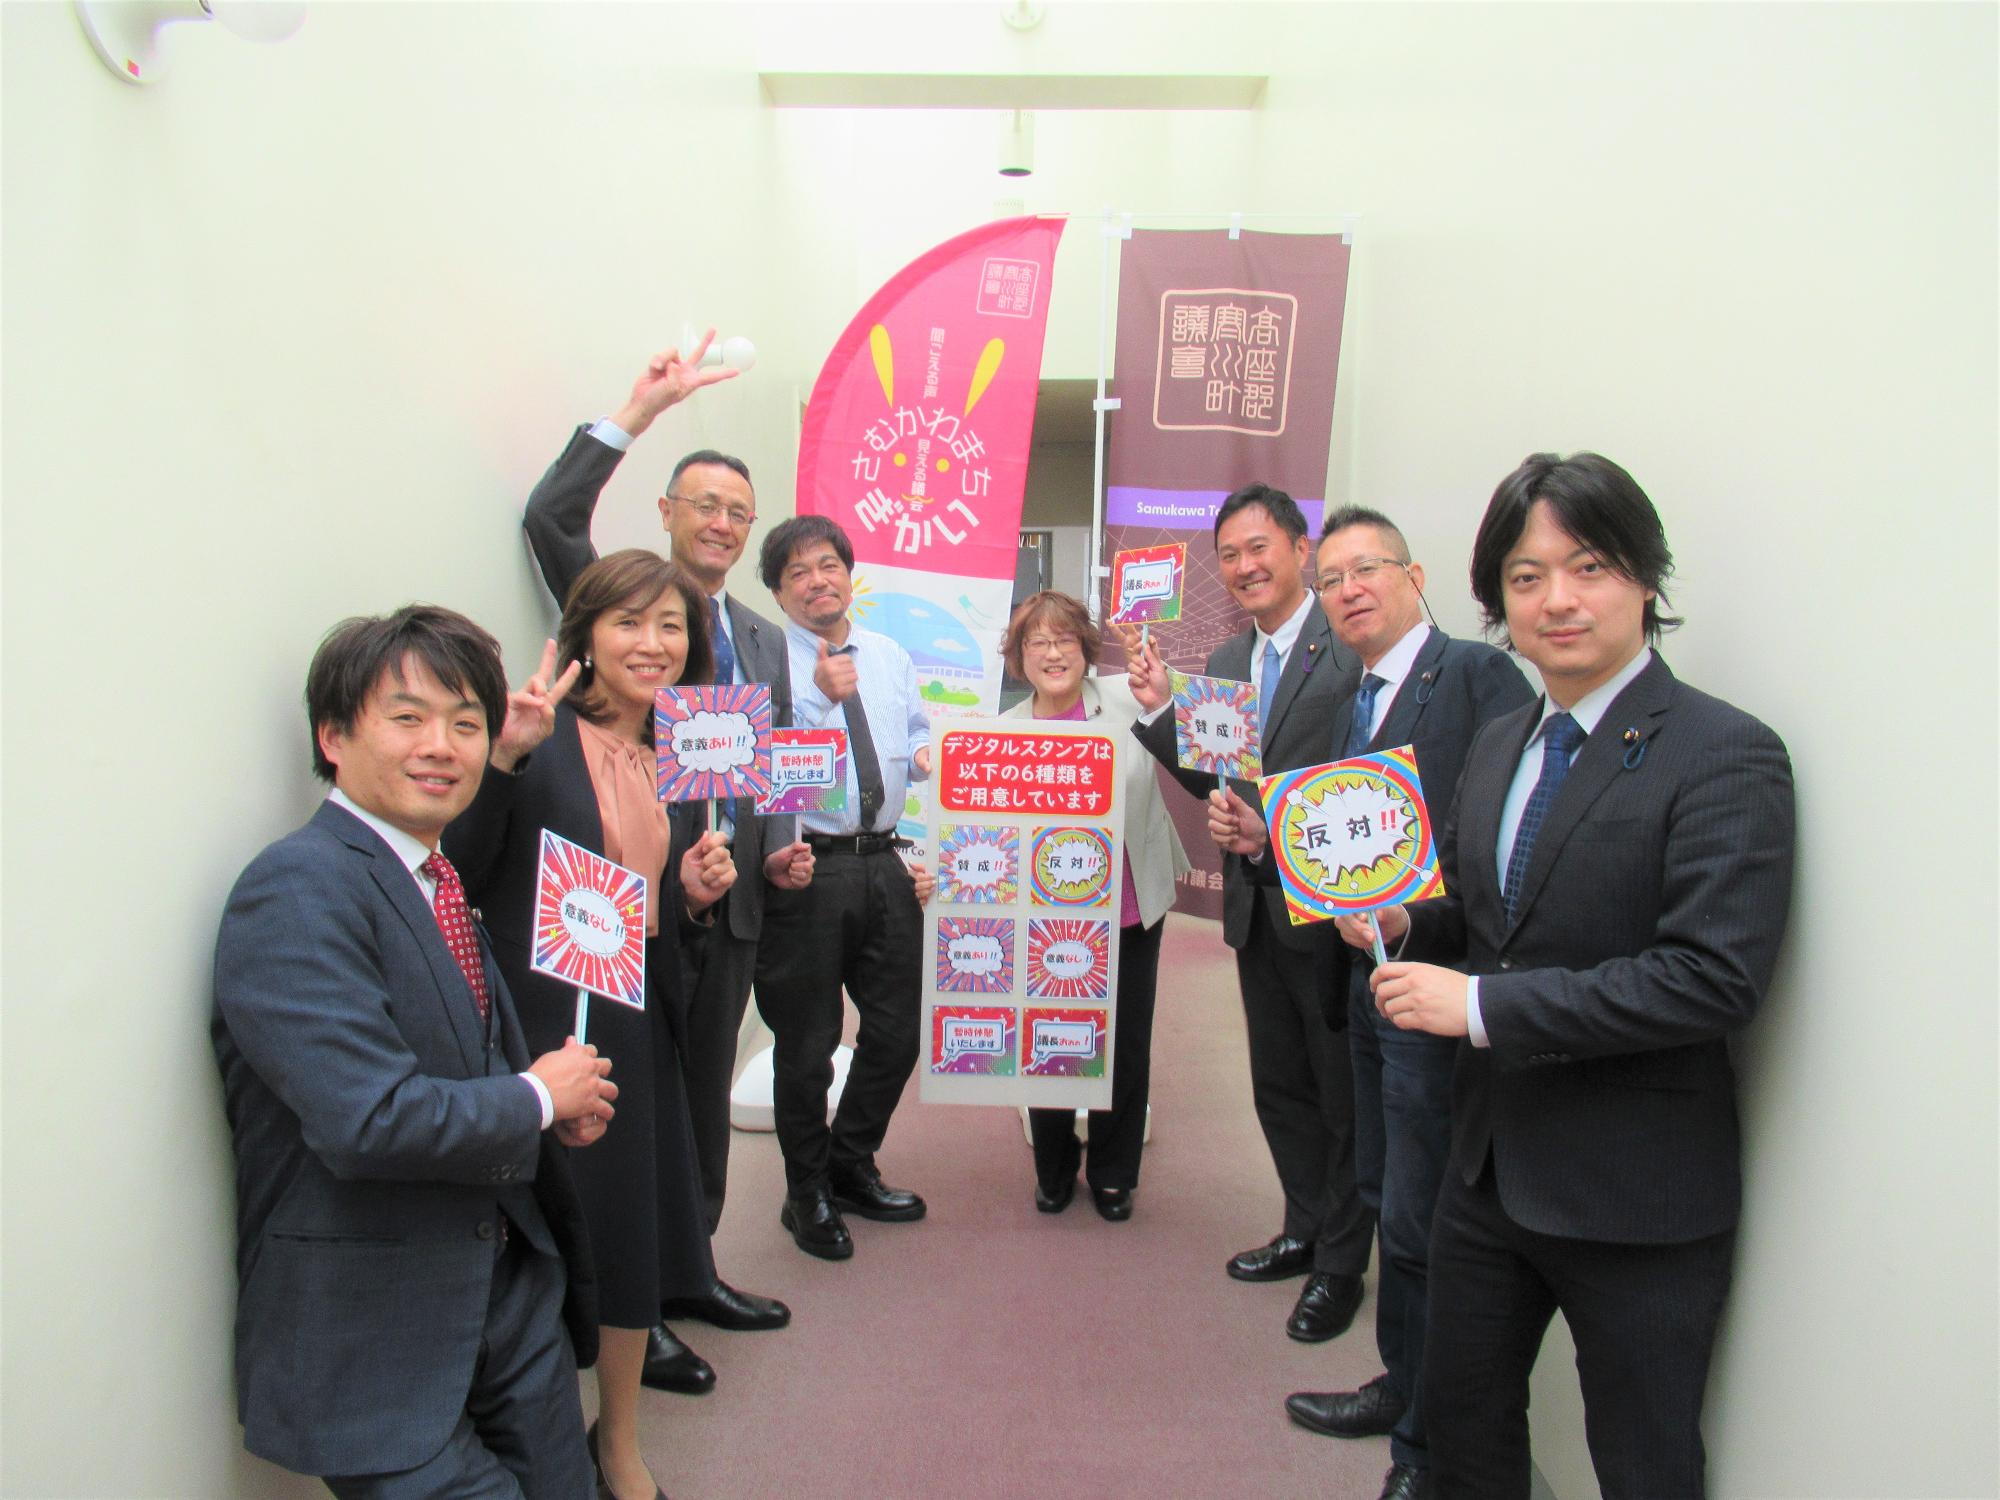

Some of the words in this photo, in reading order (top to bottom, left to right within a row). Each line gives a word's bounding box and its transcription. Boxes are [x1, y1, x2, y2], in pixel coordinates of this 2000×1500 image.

[1136, 502, 1205, 516] Samukawa
[943, 735, 1112, 761] デジタルスタンプは
[958, 762, 1094, 786] 以下の6種類を
[951, 786, 1102, 811] ご用意しています
